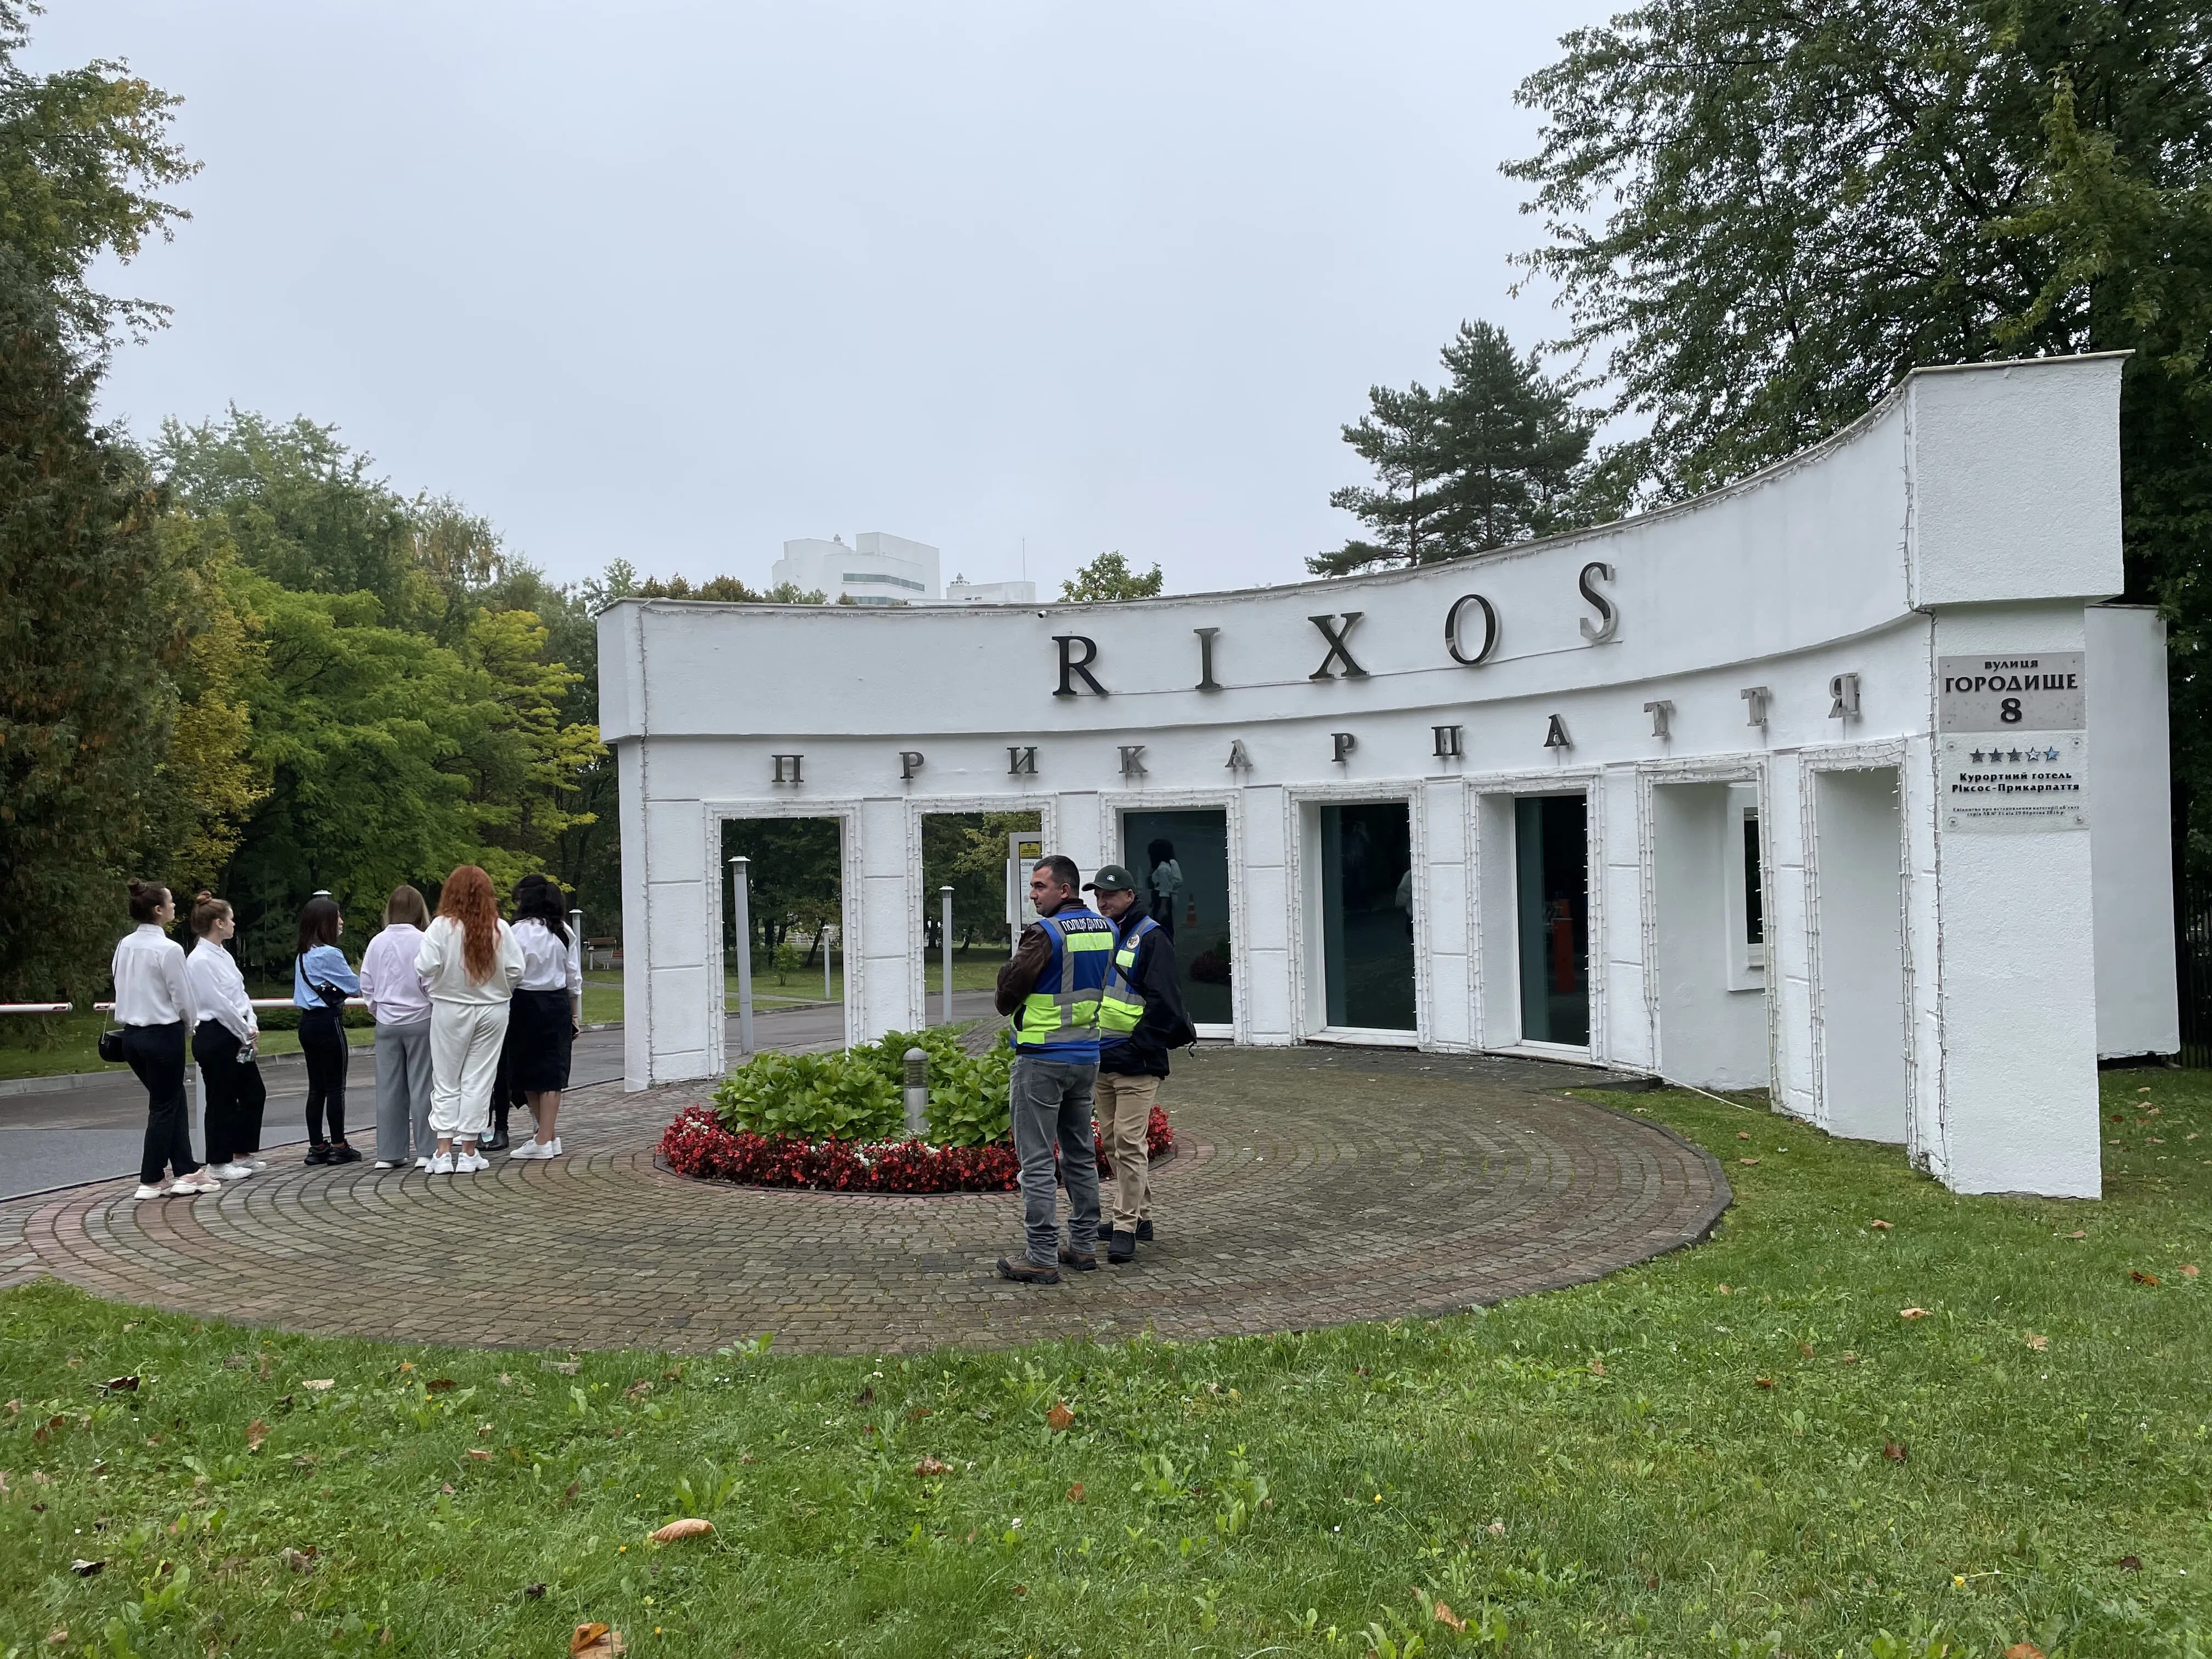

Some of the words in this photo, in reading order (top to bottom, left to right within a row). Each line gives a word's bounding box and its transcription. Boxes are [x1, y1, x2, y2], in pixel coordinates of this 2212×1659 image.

[1052, 561, 1616, 696] RIXOS
[1984, 660, 2038, 672] вулиця
[2001, 698, 2022, 723] 8
[771, 672, 1860, 783] ПРИКАРПАТТЯ
[1960, 772, 2028, 782] Курортний
